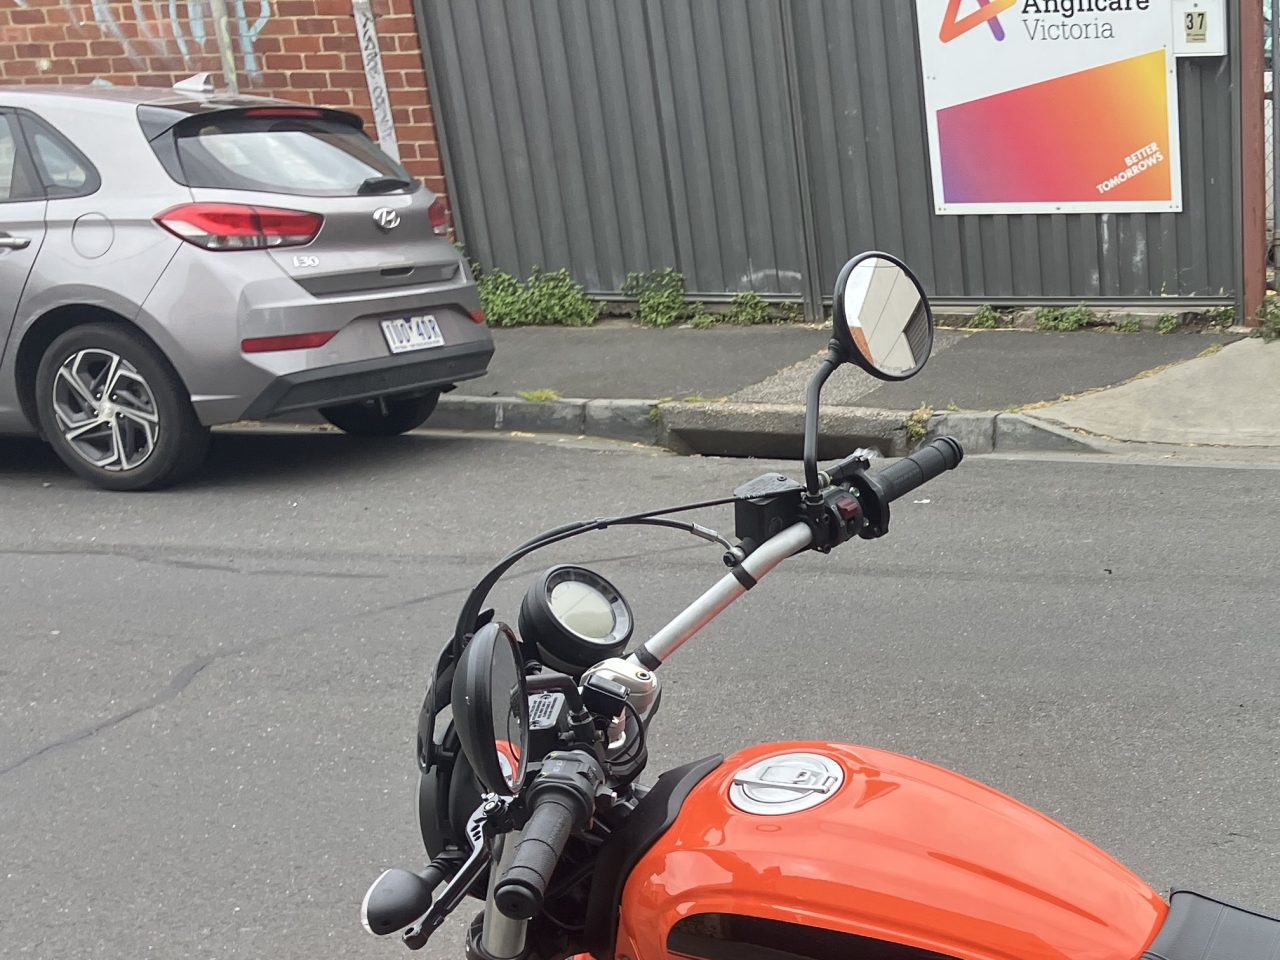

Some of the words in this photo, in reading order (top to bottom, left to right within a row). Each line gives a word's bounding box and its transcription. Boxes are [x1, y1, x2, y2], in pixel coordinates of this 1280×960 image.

[1022, 0, 1149, 18] Anglicare
[1022, 18, 1114, 40] Victoria
[1186, 13, 1204, 30] 37
[1124, 142, 1160, 166] BETTER
[1096, 152, 1164, 194] TOMORROWS
